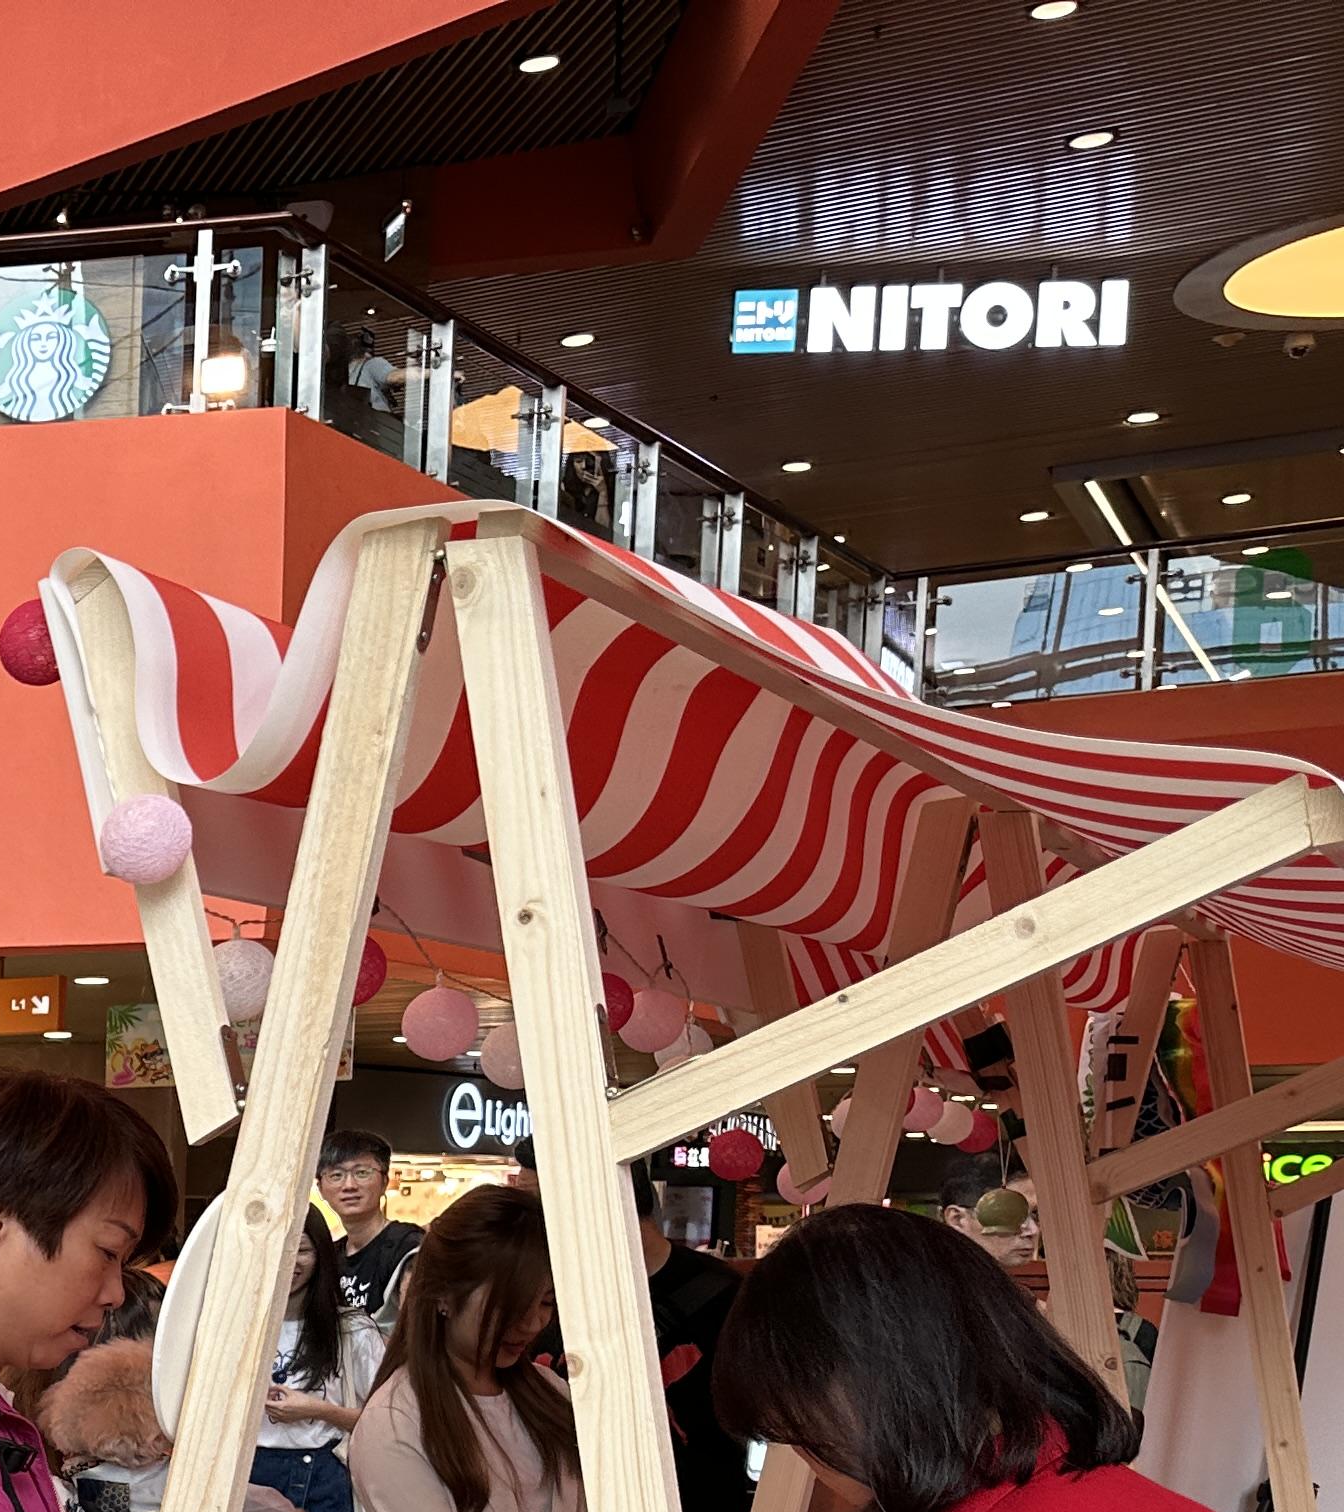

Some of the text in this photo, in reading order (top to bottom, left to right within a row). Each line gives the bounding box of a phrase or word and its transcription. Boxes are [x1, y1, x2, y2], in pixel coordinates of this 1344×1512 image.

[736, 300, 795, 325] ニトリ
[807, 280, 1130, 353] NITORI
[735, 325, 794, 343] NITORI
[11, 998, 26, 1011] L1
